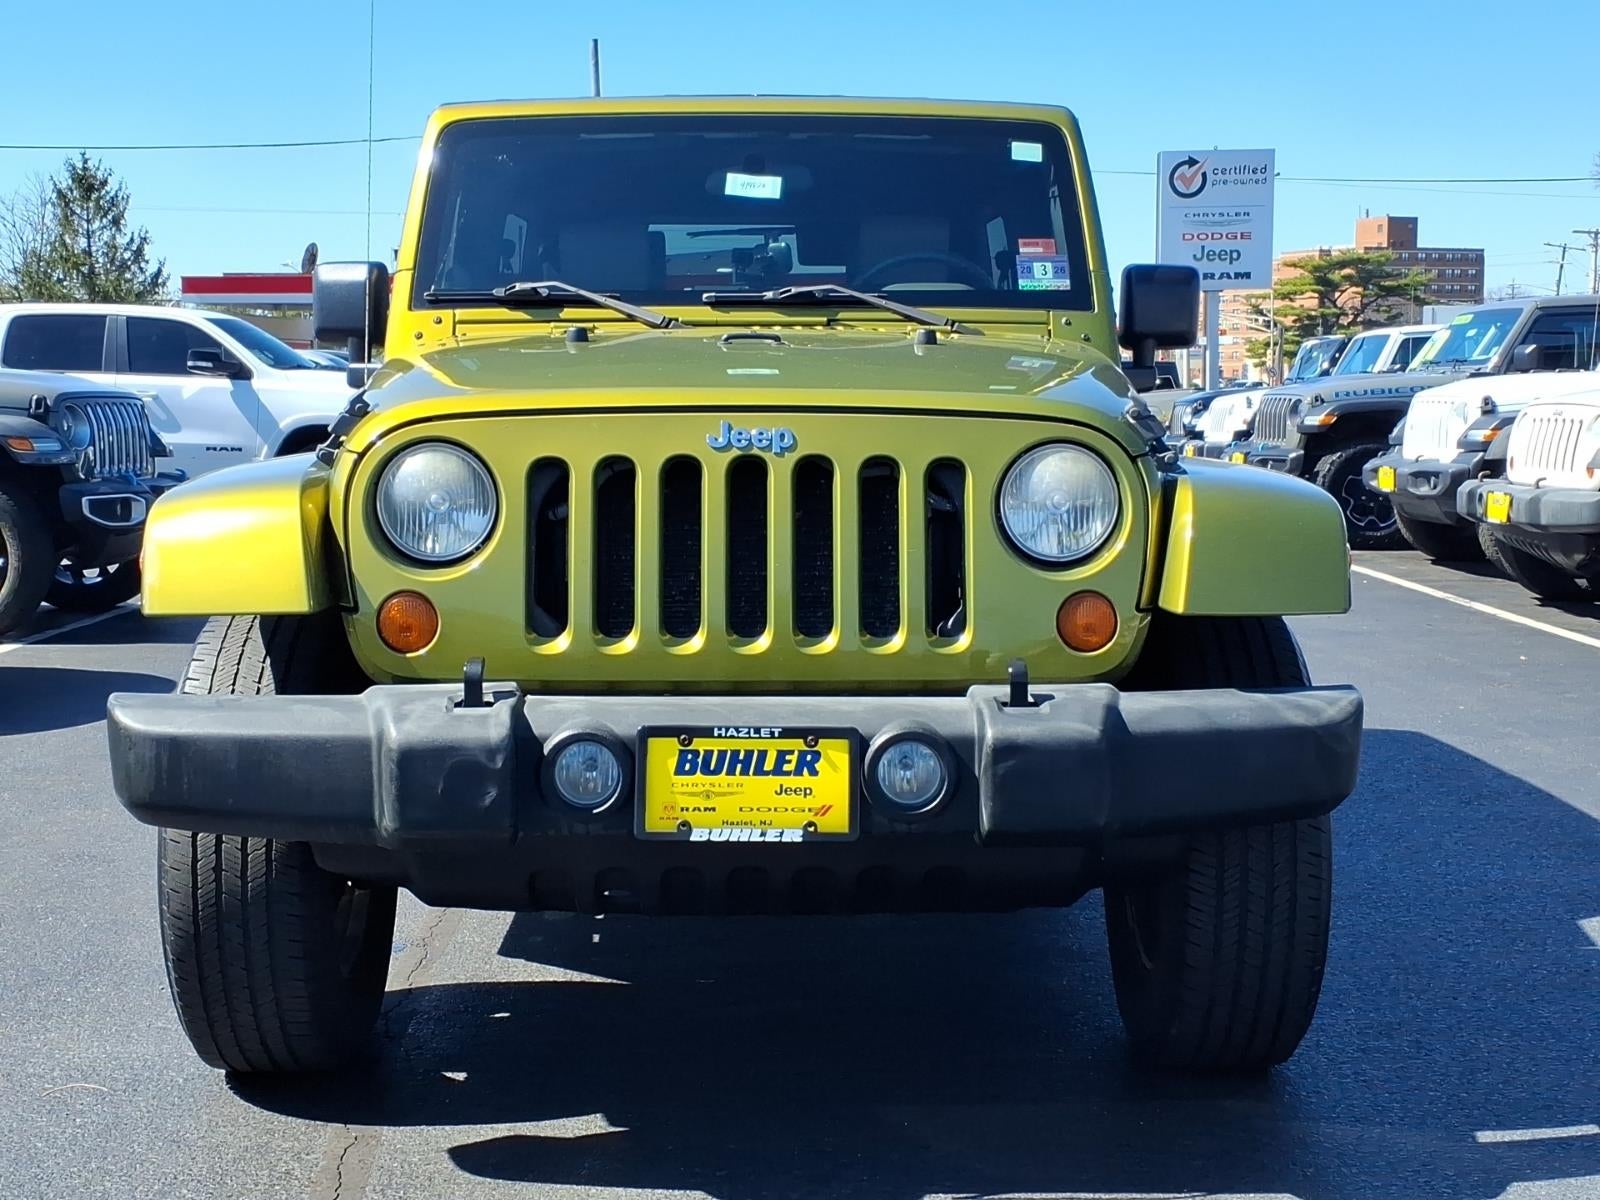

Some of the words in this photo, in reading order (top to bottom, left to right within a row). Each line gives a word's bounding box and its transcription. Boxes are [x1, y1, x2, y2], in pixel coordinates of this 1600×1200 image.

[1212, 164, 1268, 176] certified
[1211, 177, 1268, 188] pre-owned
[1182, 231, 1252, 241] DODGE
[1192, 245, 1242, 265] Jeep
[1039, 263, 1048, 277] 3
[1202, 271, 1252, 281] RAM
[706, 419, 797, 456] Jeep
[713, 727, 783, 738] HAZLET
[673, 748, 822, 777] BUHLER
[774, 783, 813, 799] Jeep
[721, 819, 756, 828] Hazlet,
[758, 819, 773, 827] NJ
[689, 828, 804, 842] BUHLER
